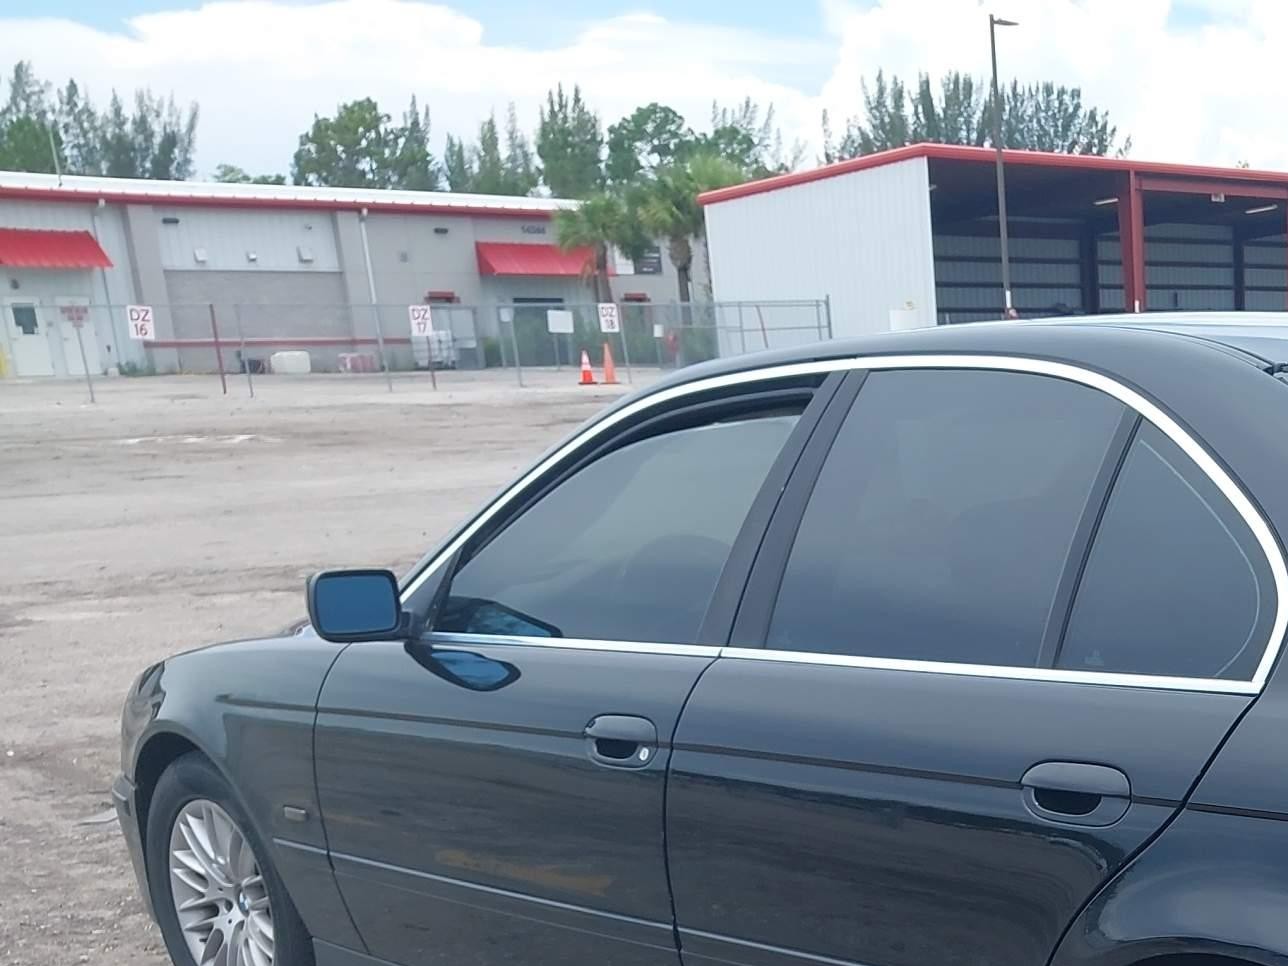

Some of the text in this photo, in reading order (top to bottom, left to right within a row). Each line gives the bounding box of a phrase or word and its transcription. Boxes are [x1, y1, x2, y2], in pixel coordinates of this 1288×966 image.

[128, 308, 151, 322] DZ
[411, 308, 430, 321] DZ
[133, 323, 149, 337] 16
[416, 321, 427, 334] 17
